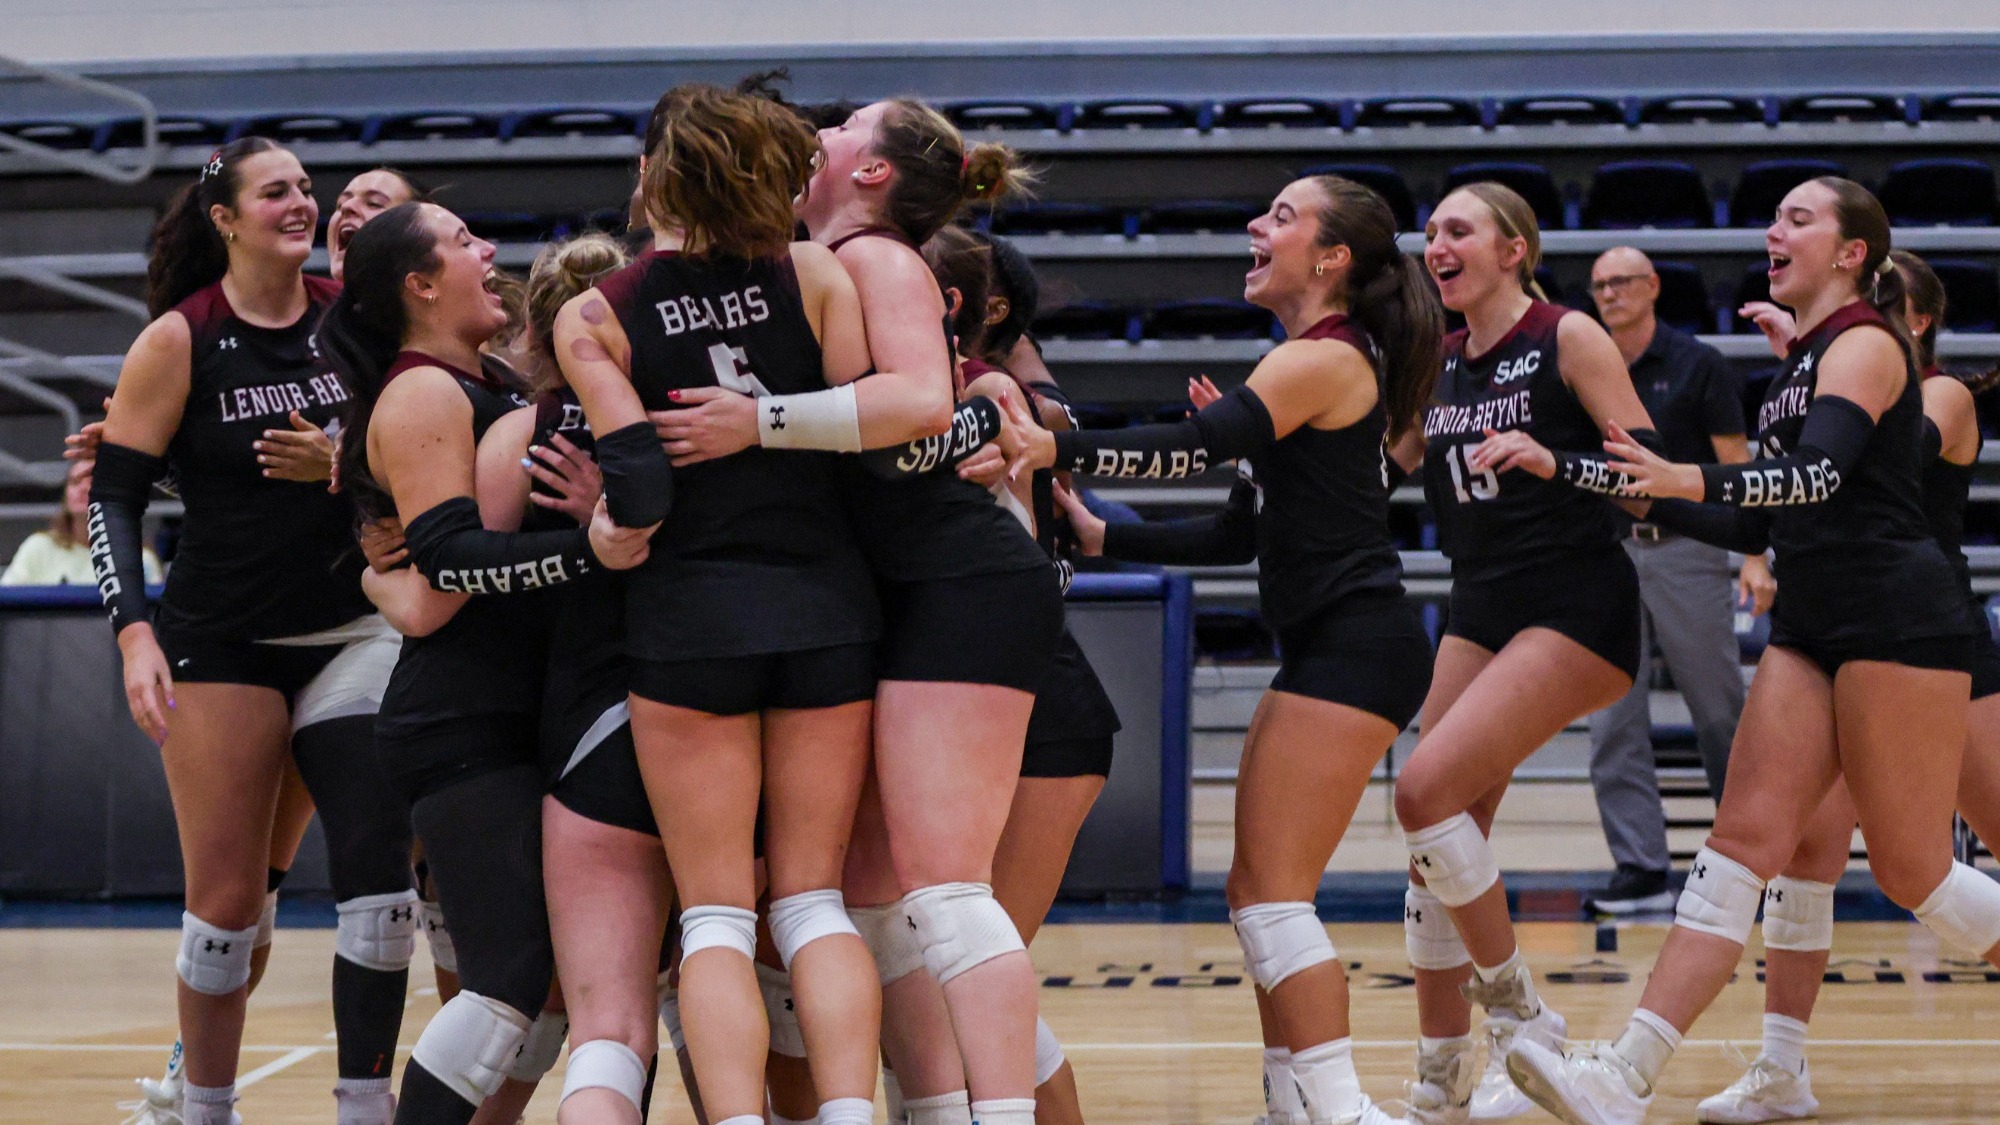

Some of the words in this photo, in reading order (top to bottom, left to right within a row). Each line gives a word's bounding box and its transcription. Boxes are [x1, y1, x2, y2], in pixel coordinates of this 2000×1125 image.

[655, 285, 770, 336] BEARS
[1493, 350, 1541, 385] SAC
[219, 372, 348, 423] LENOIR-RH
[1092, 448, 1209, 479] BEARS
[1446, 443, 1499, 503] 15
[1574, 458, 1648, 498] BEA
[1739, 457, 1842, 507] BEARS
[437, 553, 572, 595] BEARS
